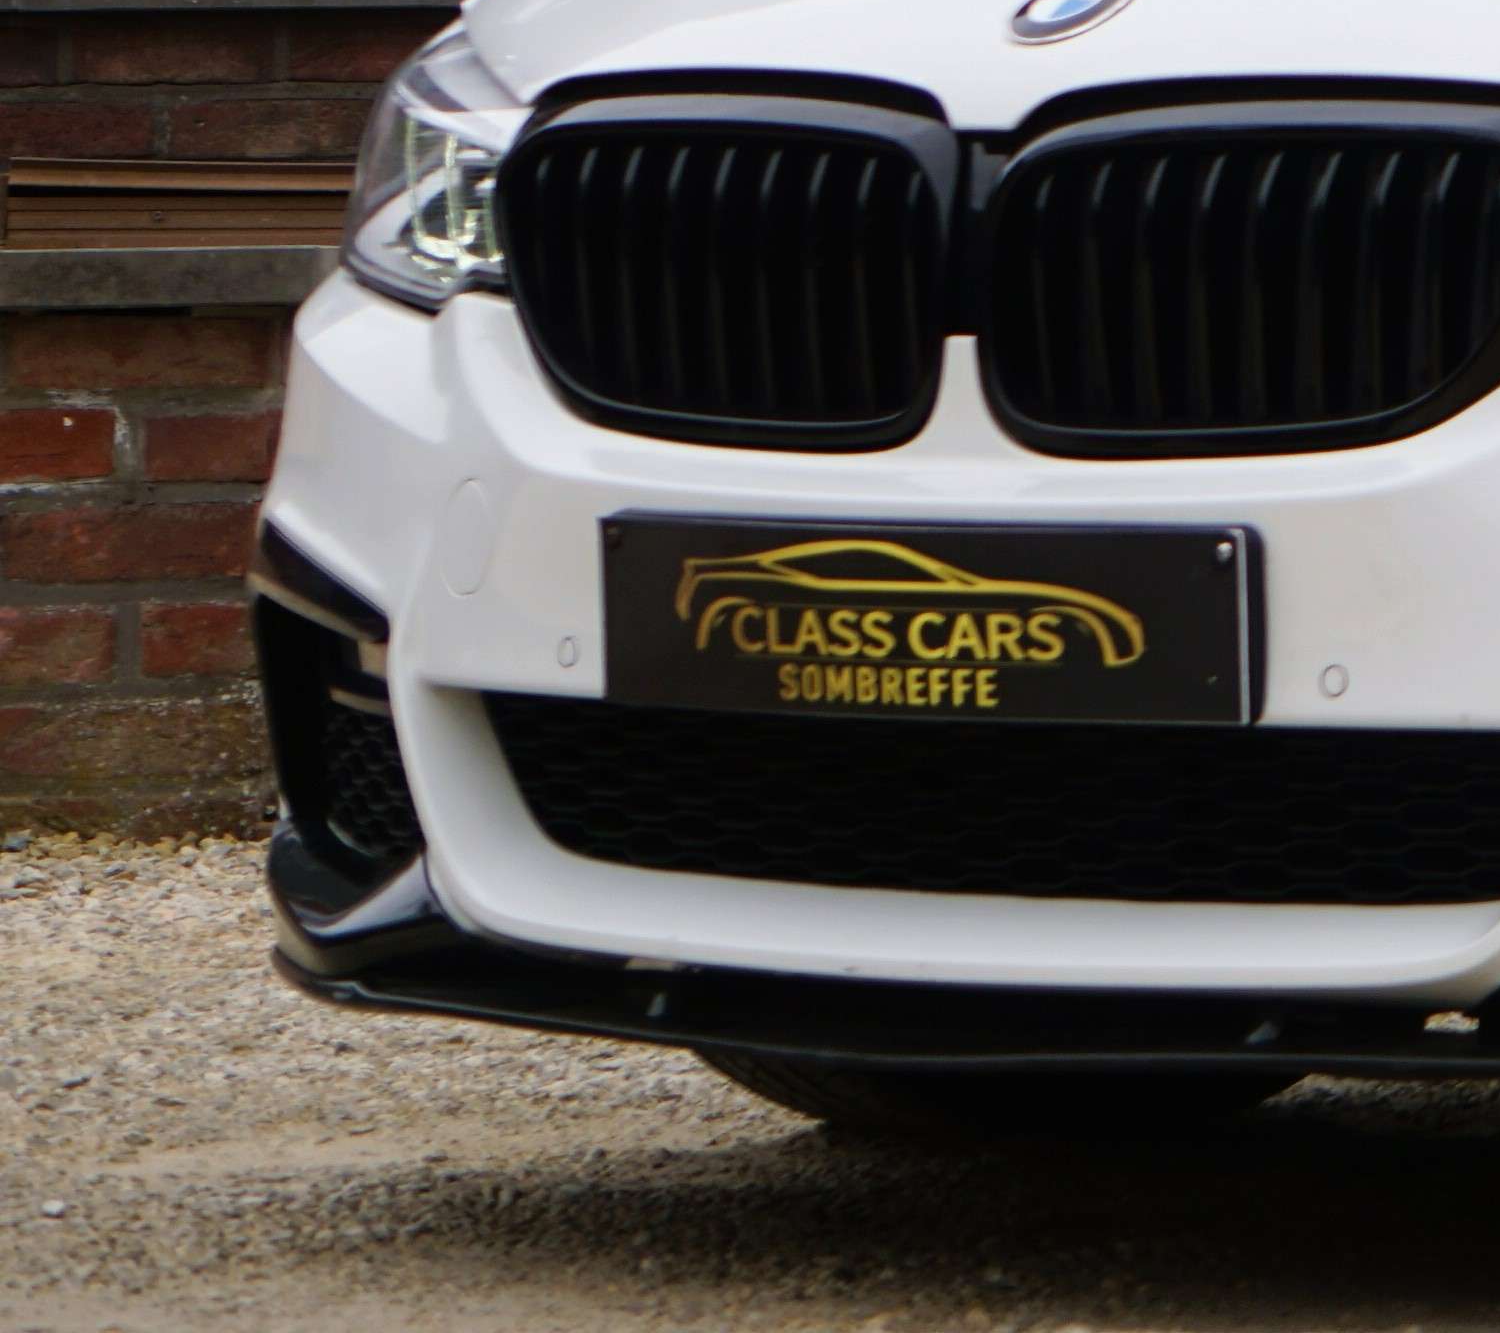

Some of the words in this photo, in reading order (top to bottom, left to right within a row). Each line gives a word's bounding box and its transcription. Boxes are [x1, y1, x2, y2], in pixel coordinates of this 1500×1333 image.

[731, 605, 897, 659] CLASS
[908, 611, 1066, 662] CARS
[777, 661, 1000, 709] SOMBREFFE
